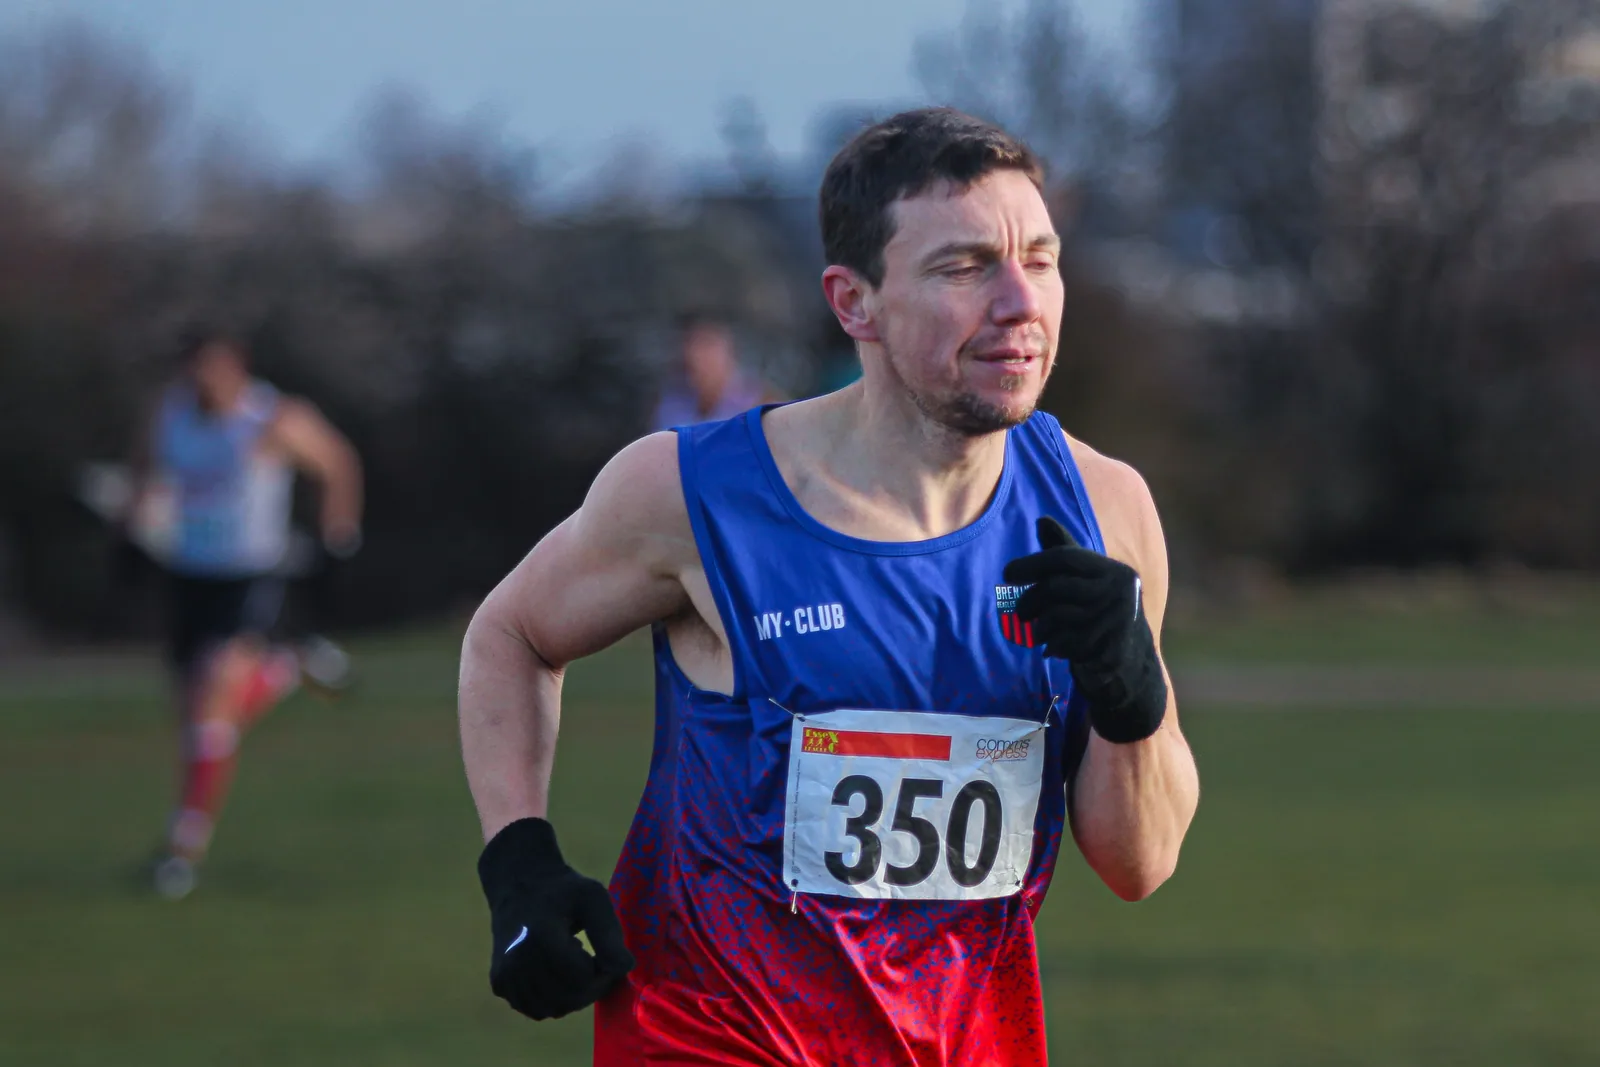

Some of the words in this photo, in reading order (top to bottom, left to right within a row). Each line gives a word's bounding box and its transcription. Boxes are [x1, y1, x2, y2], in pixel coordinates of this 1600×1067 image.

[977, 739, 1030, 751] comms
[976, 749, 1028, 763] express
[824, 774, 1003, 888] 350
